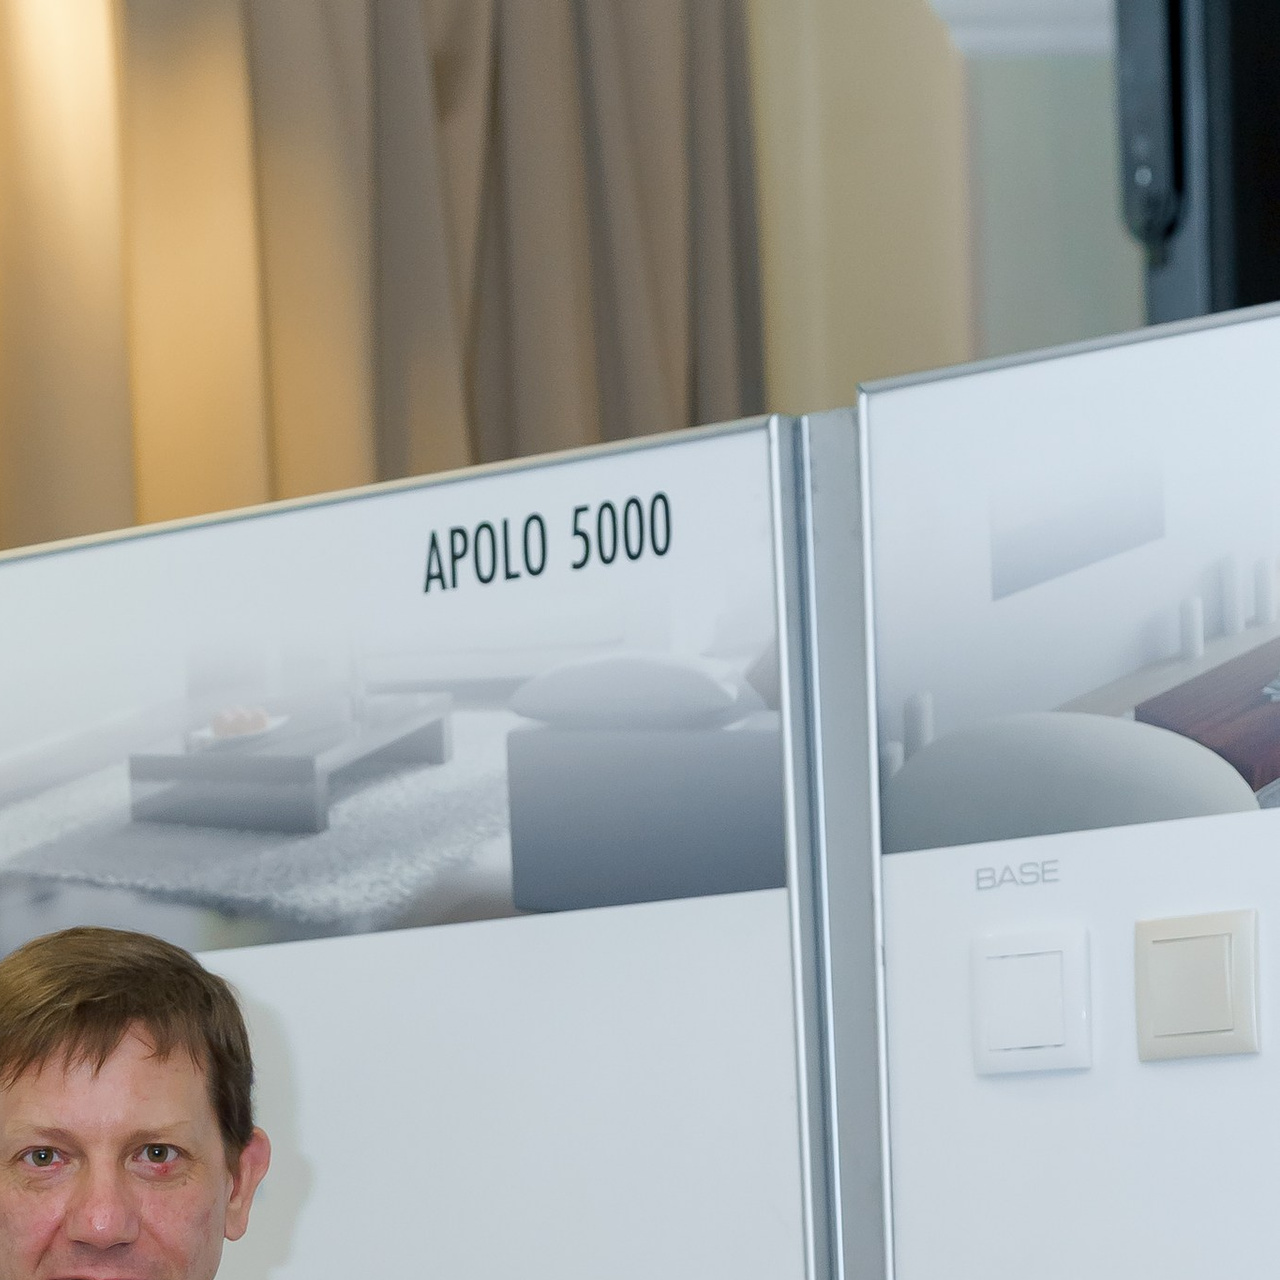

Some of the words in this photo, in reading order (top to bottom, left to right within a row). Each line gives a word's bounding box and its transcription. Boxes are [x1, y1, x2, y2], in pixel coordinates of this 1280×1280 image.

[424, 512, 546, 593] APOLO
[572, 491, 671, 569] 5000
[975, 859, 1060, 891] BASE
